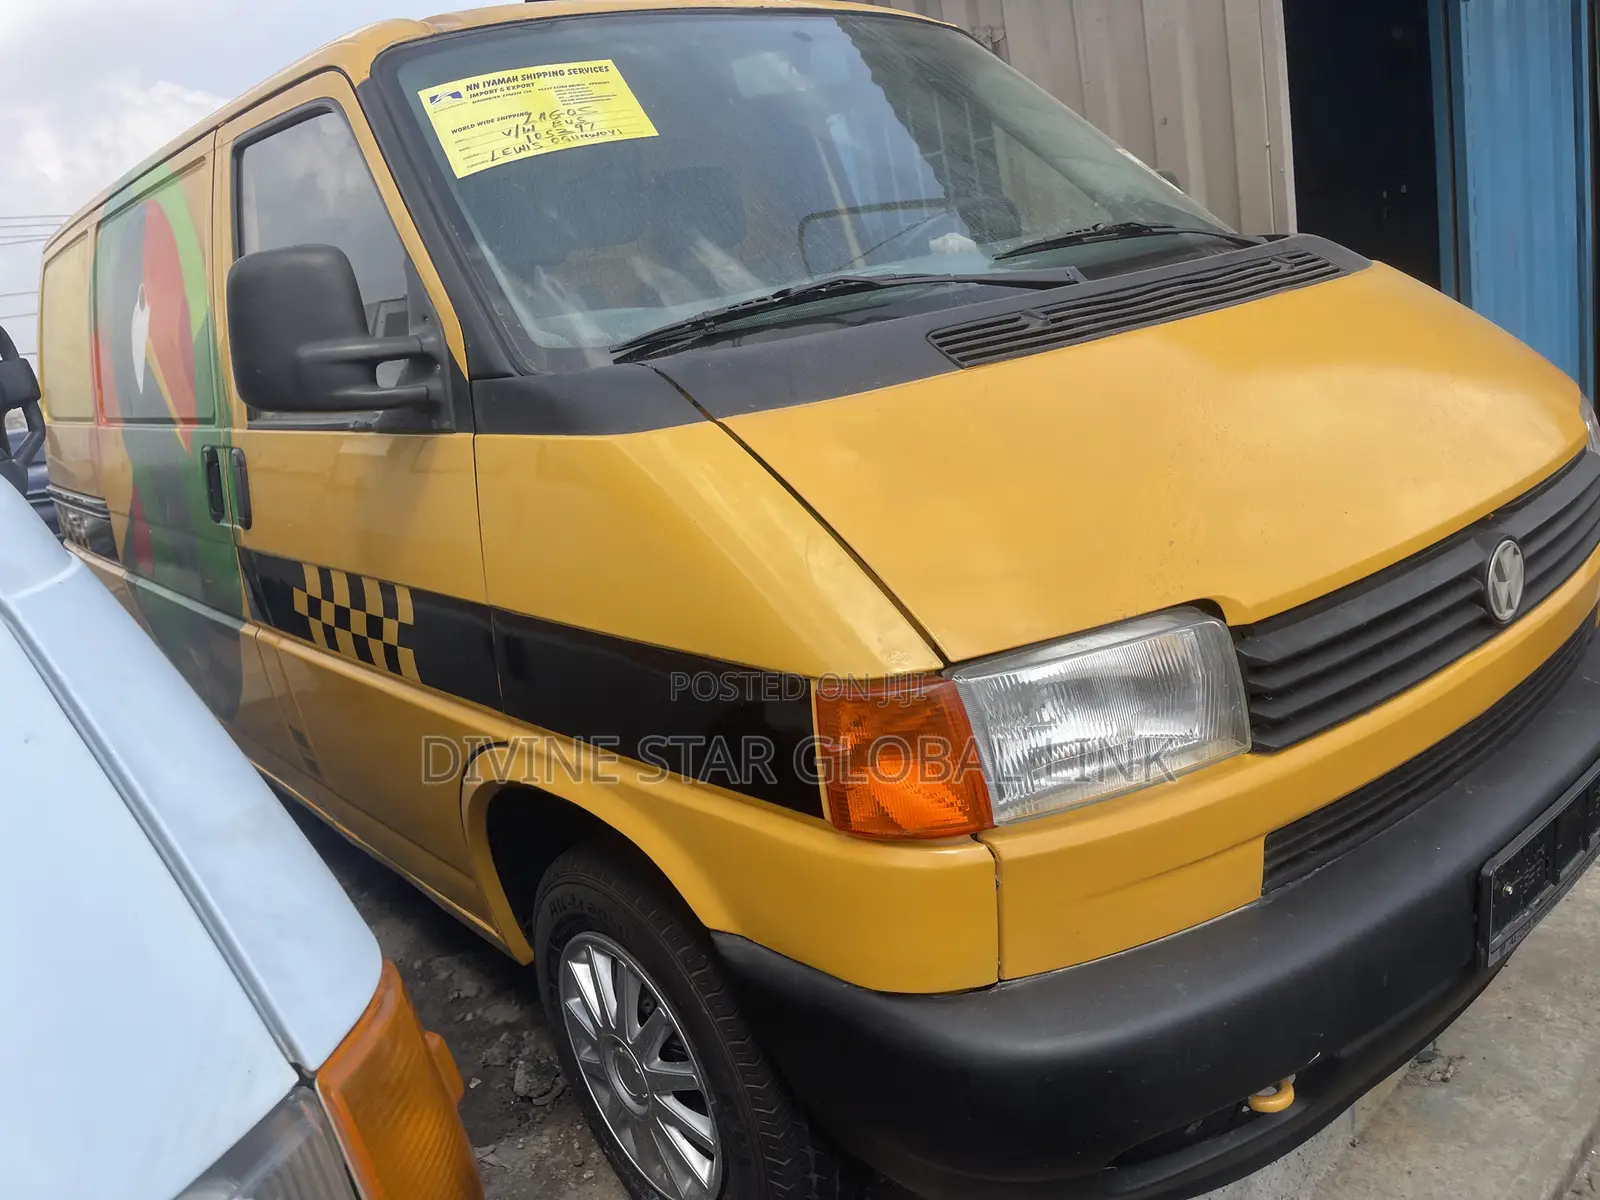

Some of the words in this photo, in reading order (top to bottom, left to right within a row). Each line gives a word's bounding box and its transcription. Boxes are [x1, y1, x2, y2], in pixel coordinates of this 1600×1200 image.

[466, 82, 480, 92] NN
[482, 75, 519, 88] IYAMAH
[521, 69, 565, 81] SHIPPING
[567, 65, 610, 76] SERVICES
[469, 88, 498, 99] IMPORT
[506, 82, 535, 91] EXPORT
[451, 123, 476, 134] WORLD
[476, 118, 495, 127] WIDE
[496, 111, 529, 122] SHIPPING
[490, 141, 543, 161] LEWIS
